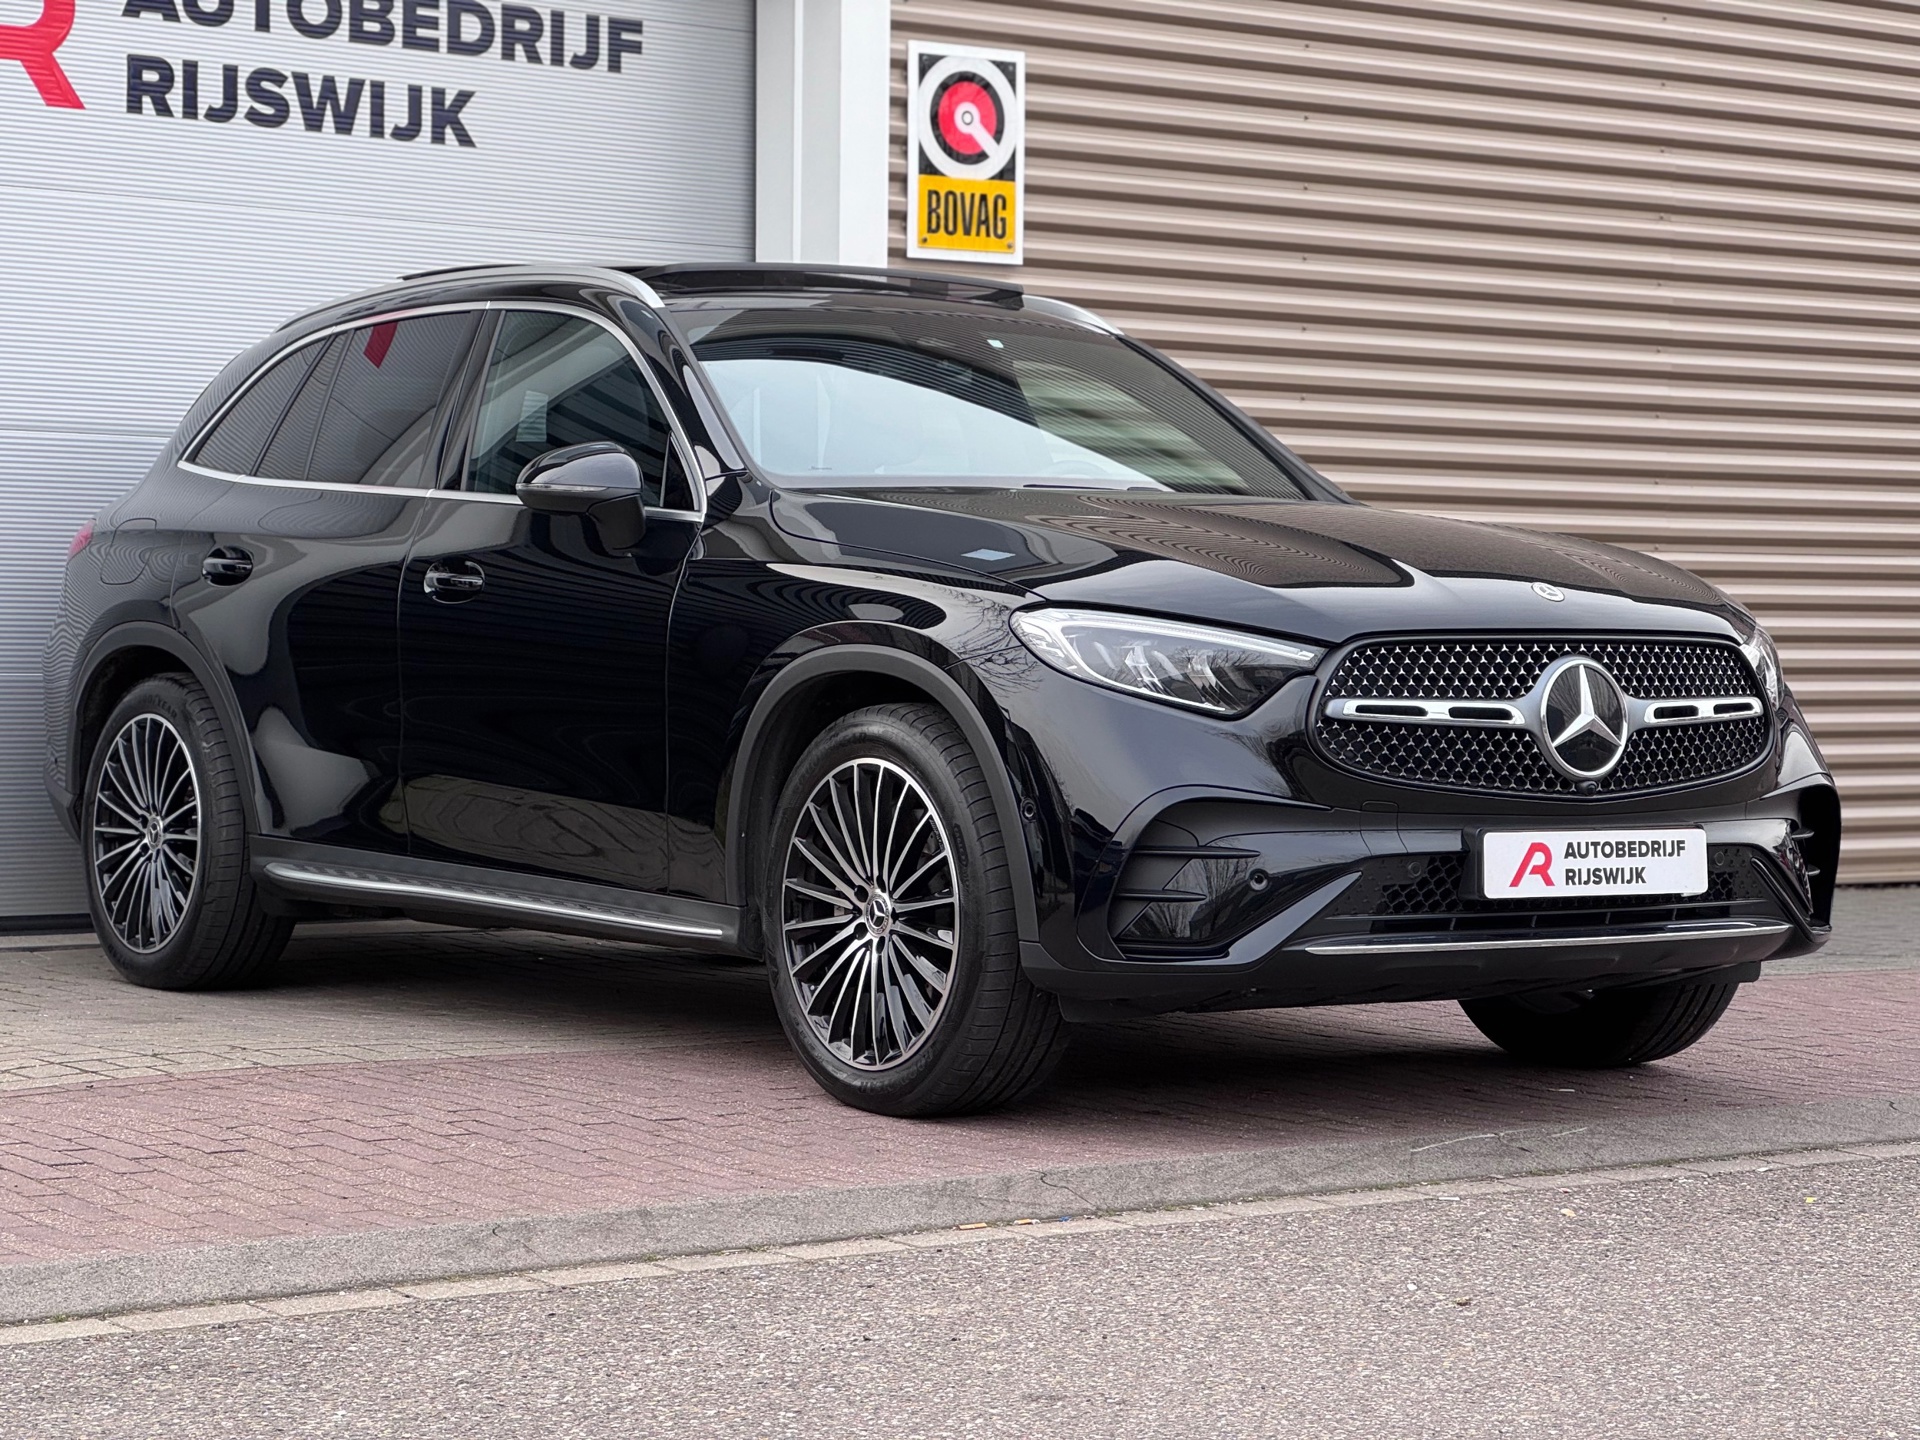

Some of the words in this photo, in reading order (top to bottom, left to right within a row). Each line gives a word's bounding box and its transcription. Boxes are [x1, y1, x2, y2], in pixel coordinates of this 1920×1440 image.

[126, 53, 477, 148] RIJSWIJK
[927, 189, 1007, 239] BOVAG
[1564, 839, 1686, 859] AUTOBEDRIJF
[1565, 866, 1647, 886] RIJSWIJK
